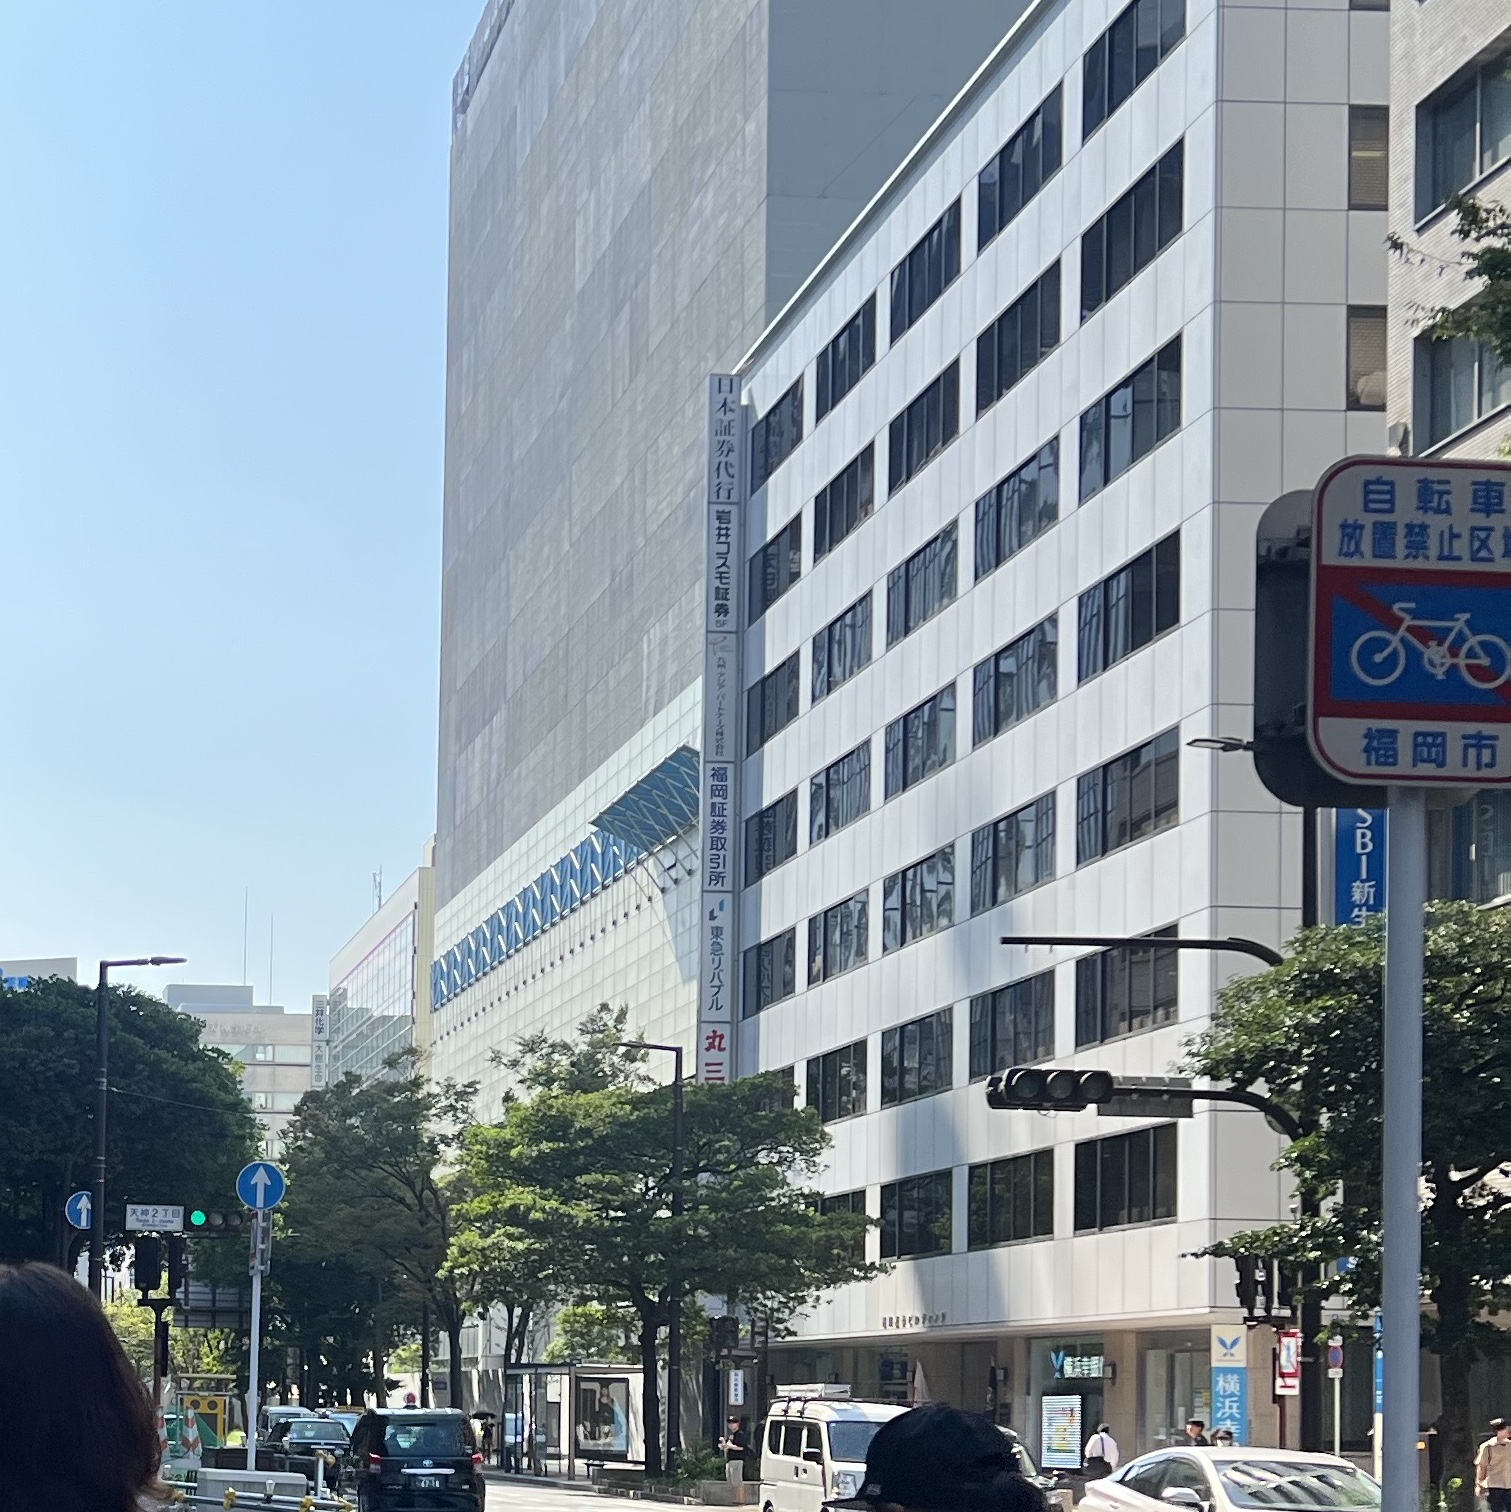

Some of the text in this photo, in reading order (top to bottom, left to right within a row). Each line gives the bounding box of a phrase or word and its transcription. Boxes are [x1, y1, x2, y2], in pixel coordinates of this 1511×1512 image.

[714, 377, 736, 500] 日本証券代行
[1363, 476, 1506, 518] 自転車
[714, 509, 732, 618] 岩井コスモ証券
[1362, 727, 1500, 771] 福岡市
[708, 766, 728, 888] 福岡証券取引所
[708, 925, 725, 1012] 東急リバブル
[130, 1207, 181, 1218] 天神2丁目
